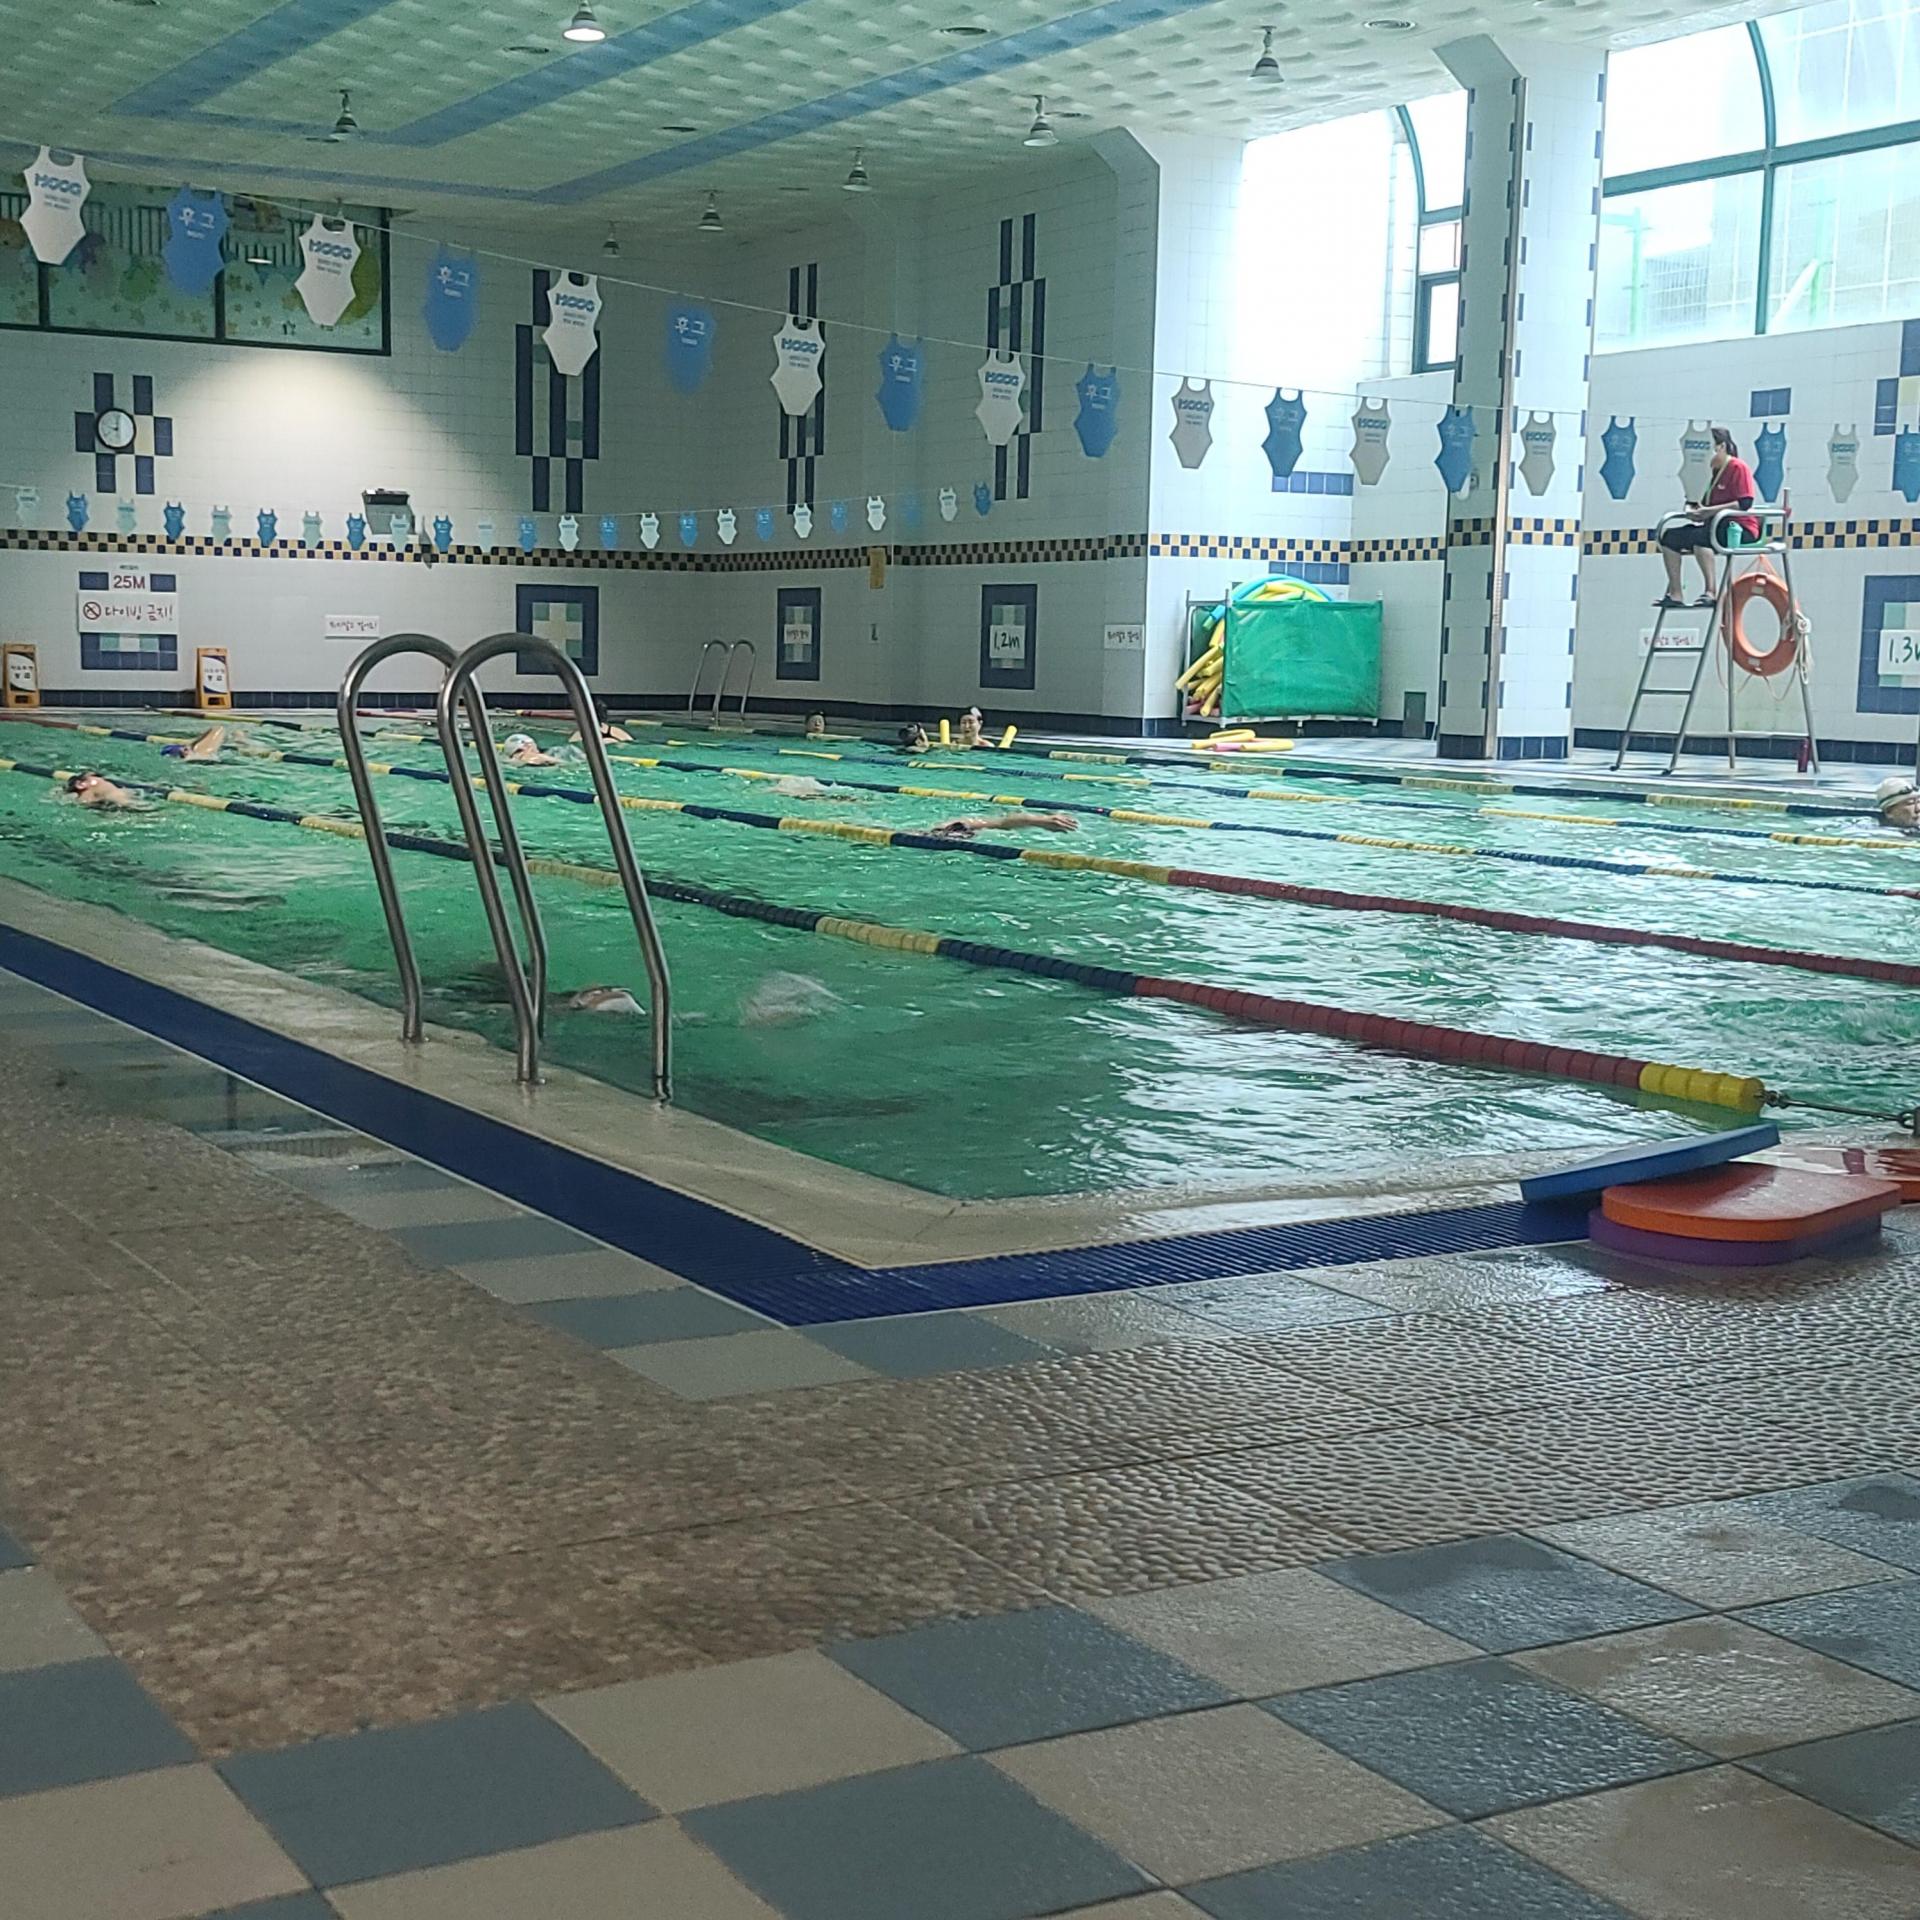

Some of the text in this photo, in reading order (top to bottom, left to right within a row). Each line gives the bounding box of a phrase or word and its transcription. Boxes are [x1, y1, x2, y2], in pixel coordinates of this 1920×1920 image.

[675, 316, 706, 335] 후그
[113, 575, 145, 589] 25M
[105, 604, 173, 621] 다이빙 금지!
[993, 632, 1020, 650] 1.2m
